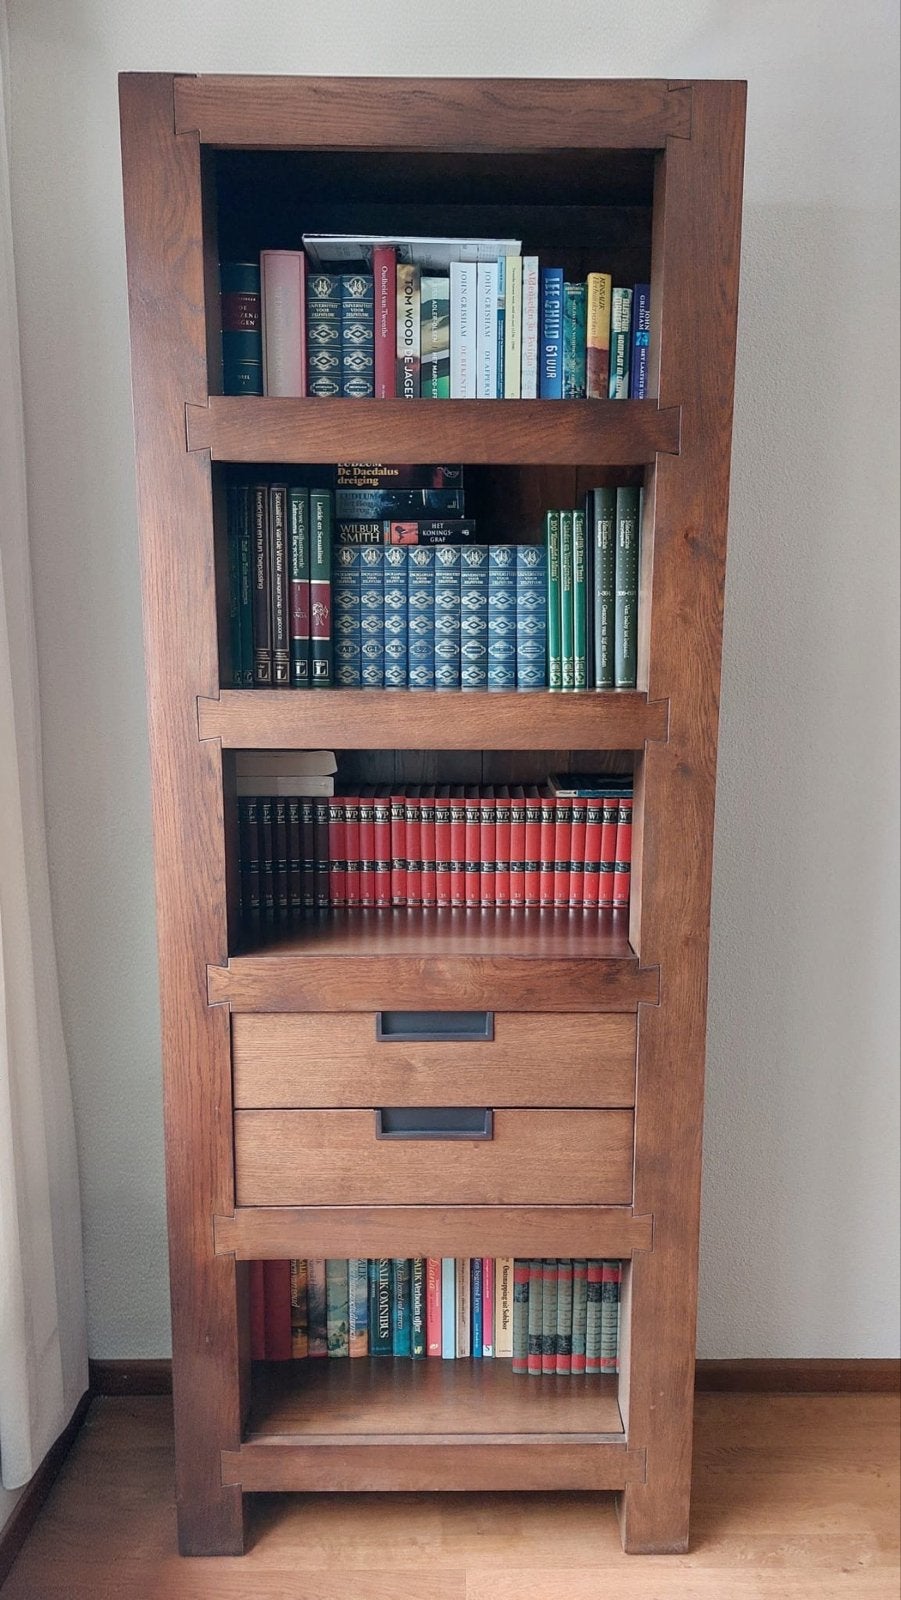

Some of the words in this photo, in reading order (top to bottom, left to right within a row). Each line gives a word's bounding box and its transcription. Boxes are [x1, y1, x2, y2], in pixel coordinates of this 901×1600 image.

[545, 277, 560, 296] LEE
[404, 280, 413, 305] TOM
[545, 300, 559, 339] CHILD
[404, 308, 413, 346] WOOD
[545, 345, 558, 357] 61
[404, 349, 413, 363] DE
[546, 359, 557, 378] UUR
[337, 467, 351, 476] De
[353, 467, 399, 476] Daedalus
[337, 476, 379, 487] dreiging
[340, 524, 380, 533] WILBUR
[340, 533, 380, 543] SMITH
[330, 810, 343, 818] WP
[345, 810, 358, 819] WP
[361, 810, 374, 818] WP
[375, 810, 389, 819] WP
[391, 808, 404, 817] WP
[406, 810, 419, 819] WP
[421, 811, 434, 819] WP
[436, 811, 449, 820] WP
[452, 811, 465, 819] WP
[466, 811, 479, 820] WP
[482, 811, 495, 820] WP
[496, 811, 510, 819] WP
[512, 811, 525, 819] WP
[429, 1258, 439, 1289] Diana
[501, 1265, 509, 1300] Ontsnapping
[380, 1291, 389, 1339] OMNIBUS
[413, 1316, 422, 1333] offer
